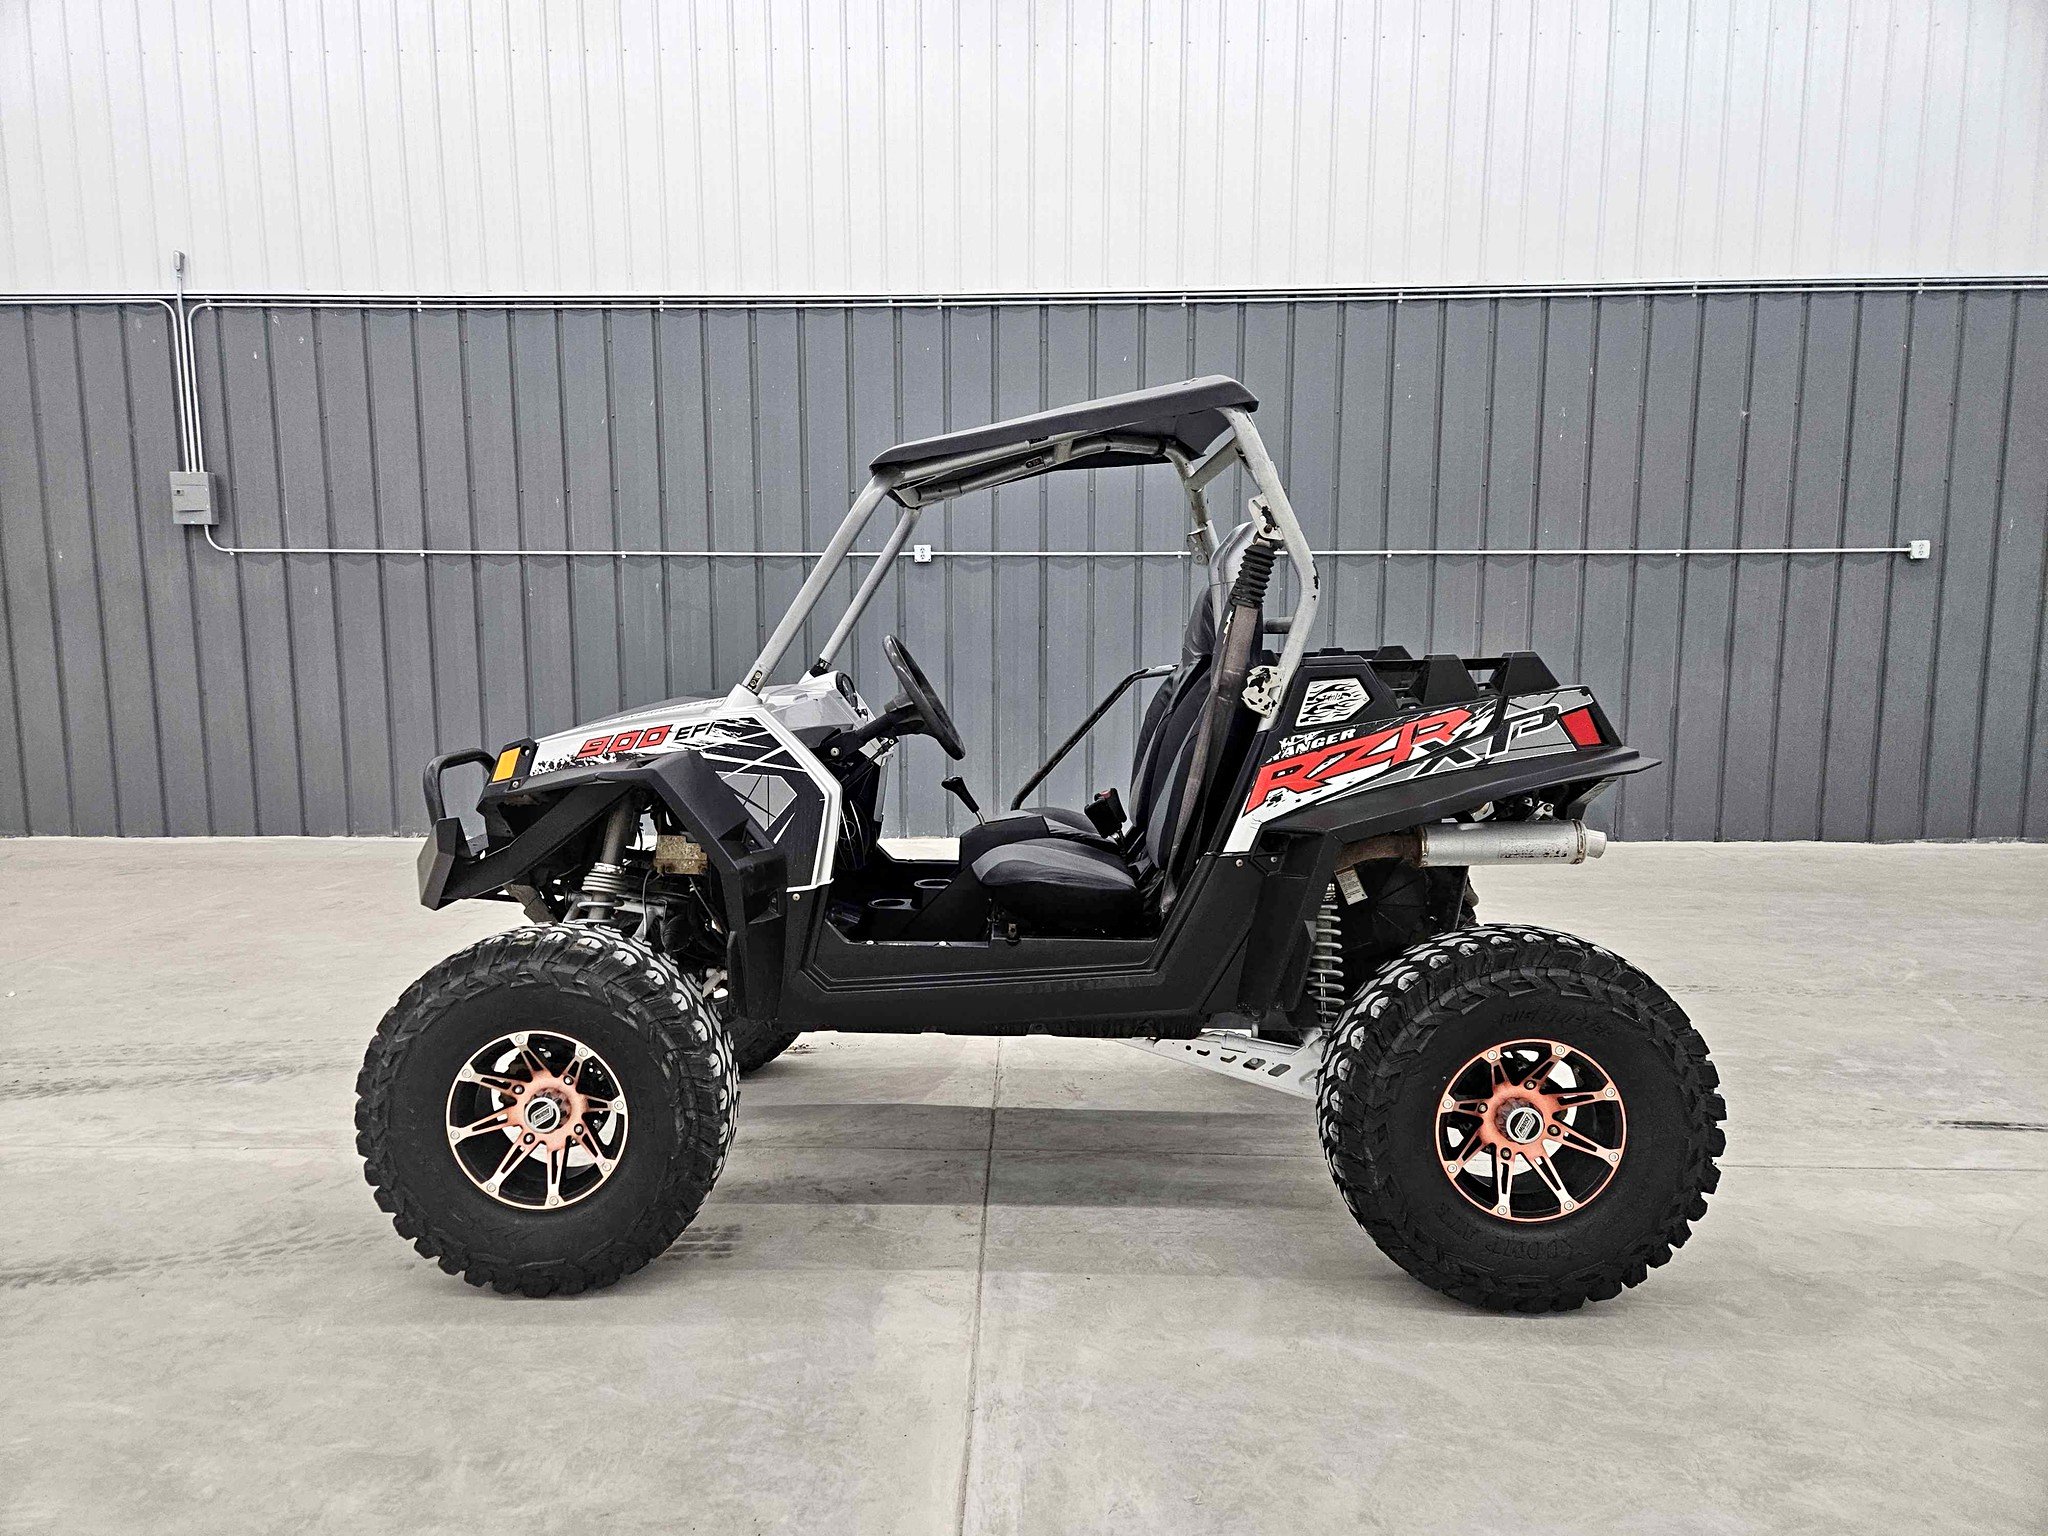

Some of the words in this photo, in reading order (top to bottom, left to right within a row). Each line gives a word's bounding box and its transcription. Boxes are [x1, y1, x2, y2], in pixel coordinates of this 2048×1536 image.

[576, 724, 673, 759] 900
[674, 721, 716, 741] EFI
[1243, 708, 1473, 818] RZR
[1409, 703, 1562, 778] XP
